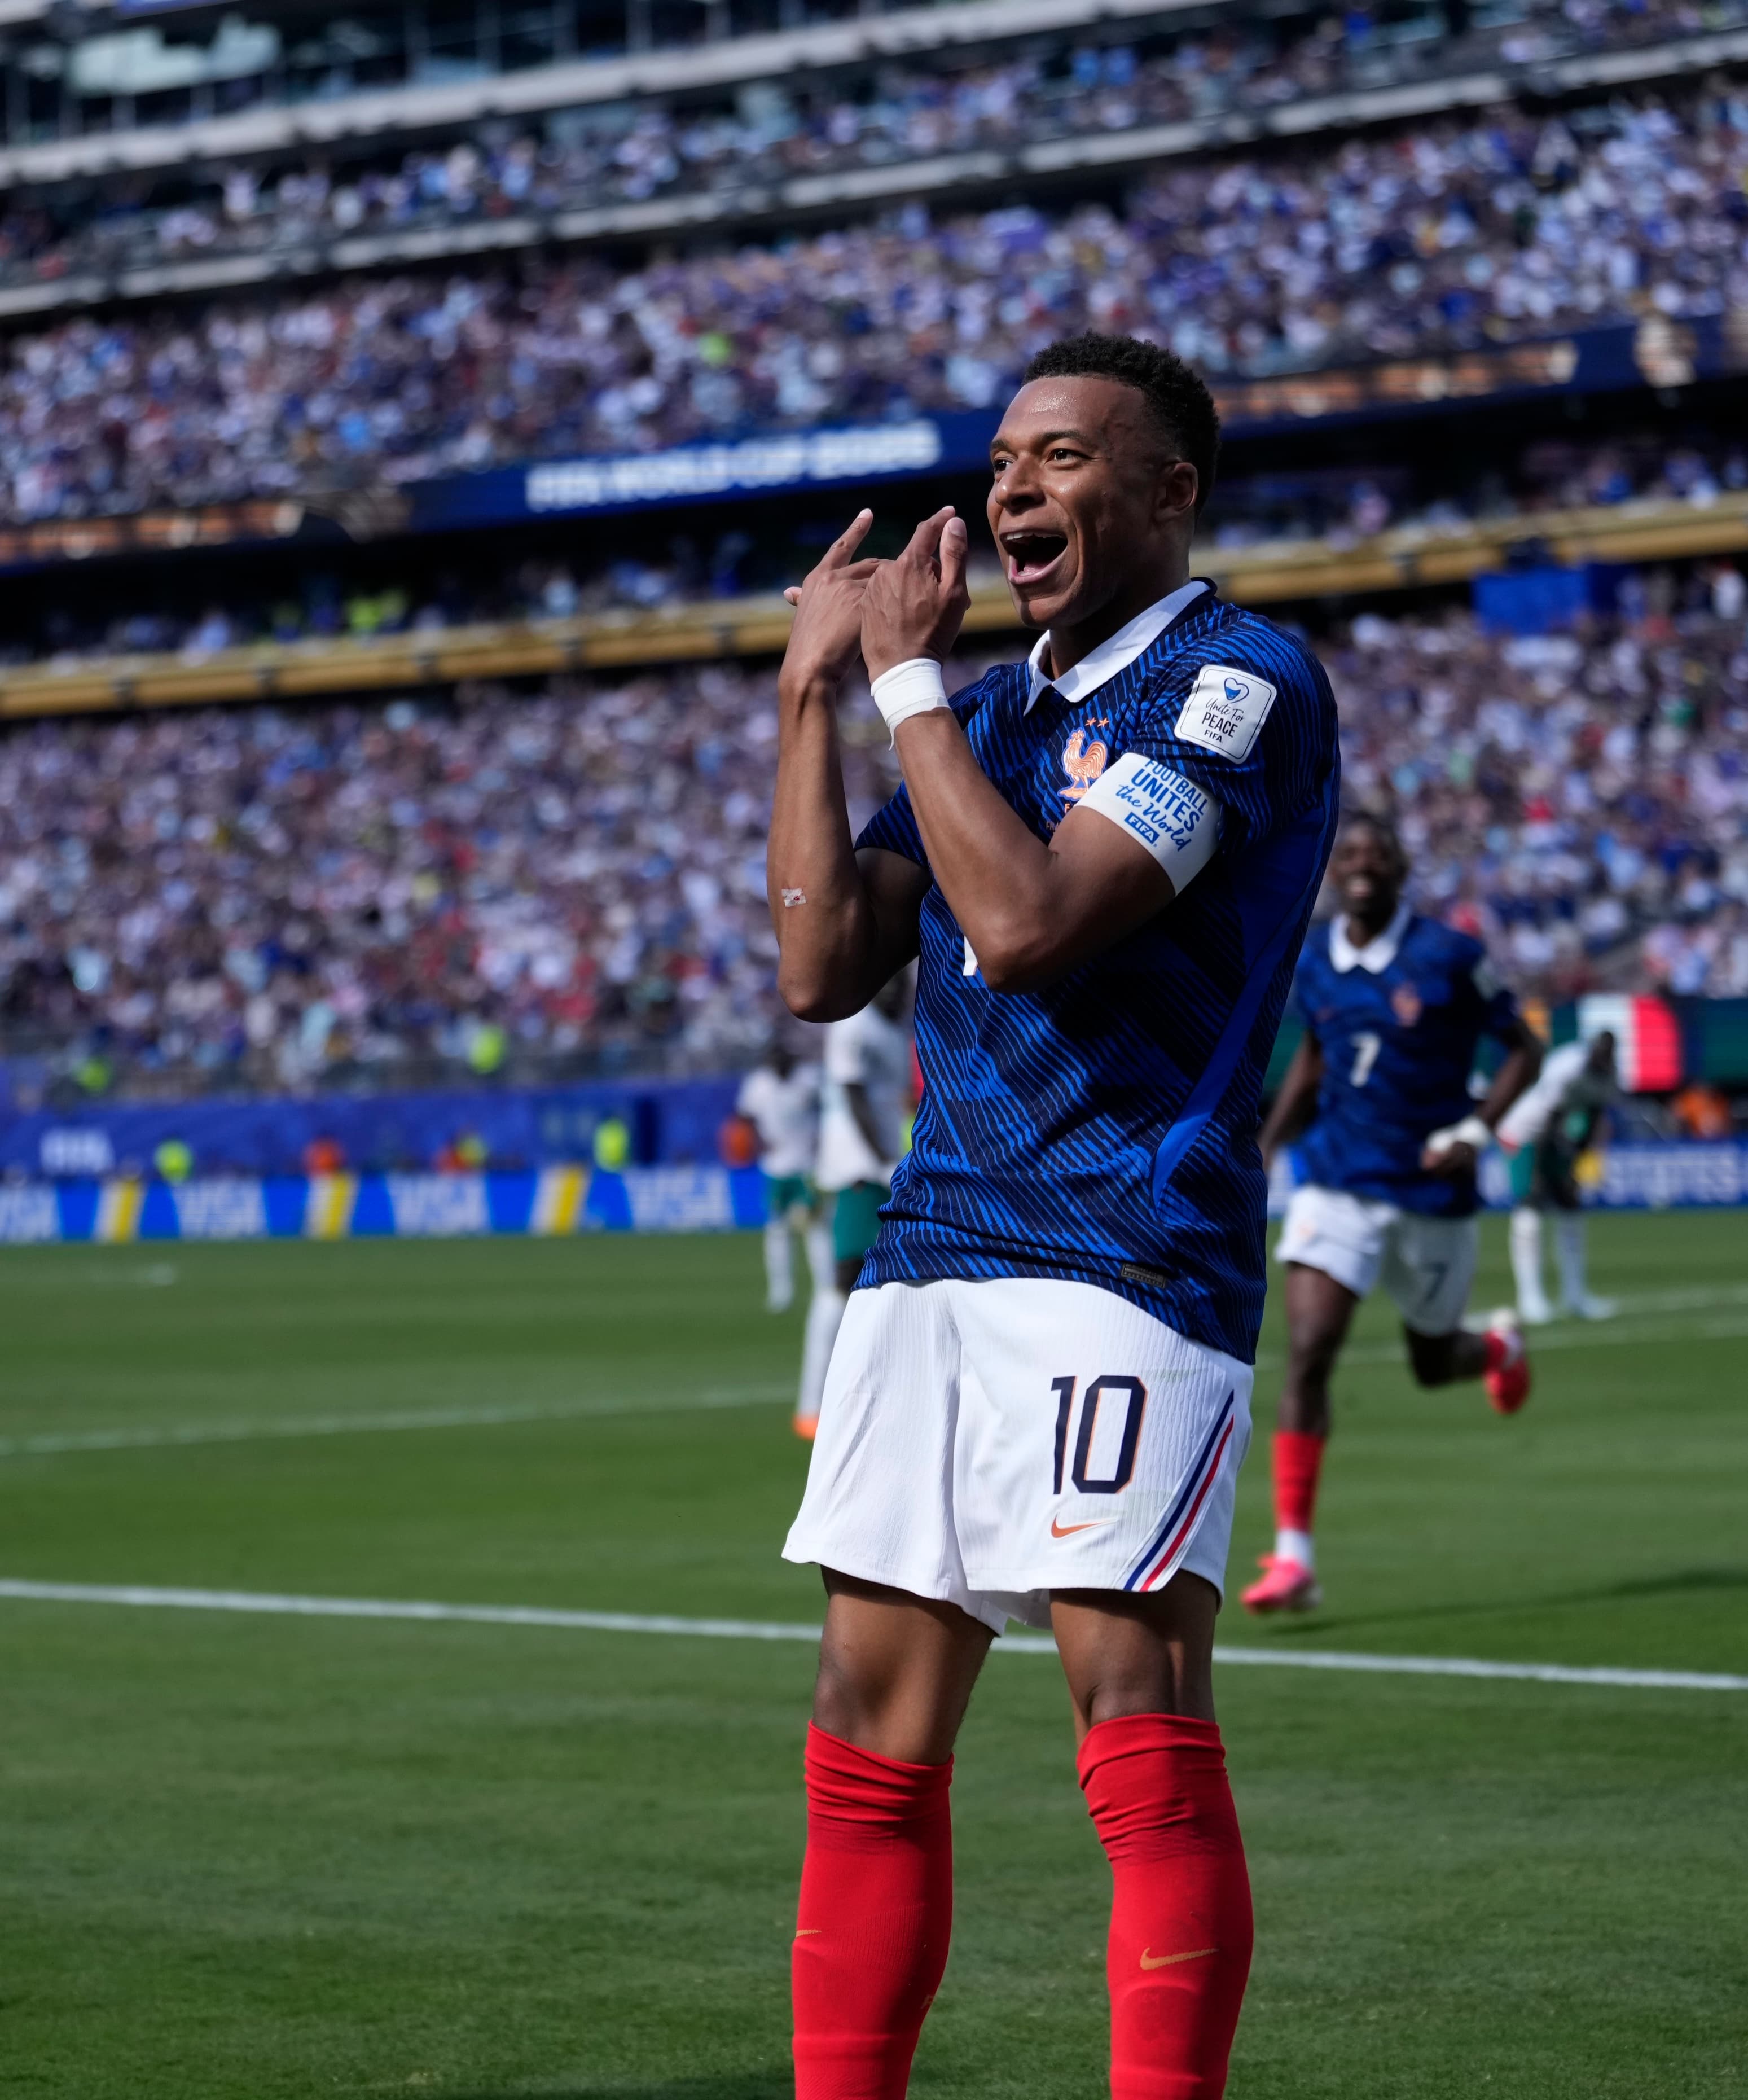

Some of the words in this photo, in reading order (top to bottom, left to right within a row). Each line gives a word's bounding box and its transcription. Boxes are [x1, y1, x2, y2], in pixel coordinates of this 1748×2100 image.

[1201, 712, 1238, 738] PEACE
[1205, 698, 1231, 716] Unite
[1231, 708, 1245, 722] For
[1204, 730, 1222, 743] FIFA
[1115, 784, 1142, 807] the
[1131, 768, 1200, 832] UNITES
[1128, 813, 1157, 842] FIFA
[1142, 803, 1192, 852] World
[1350, 1031, 1381, 1087] 7
[386, 1173, 490, 1233] VISA
[622, 1168, 731, 1228] VISA
[1051, 1375, 1148, 1494] 10
